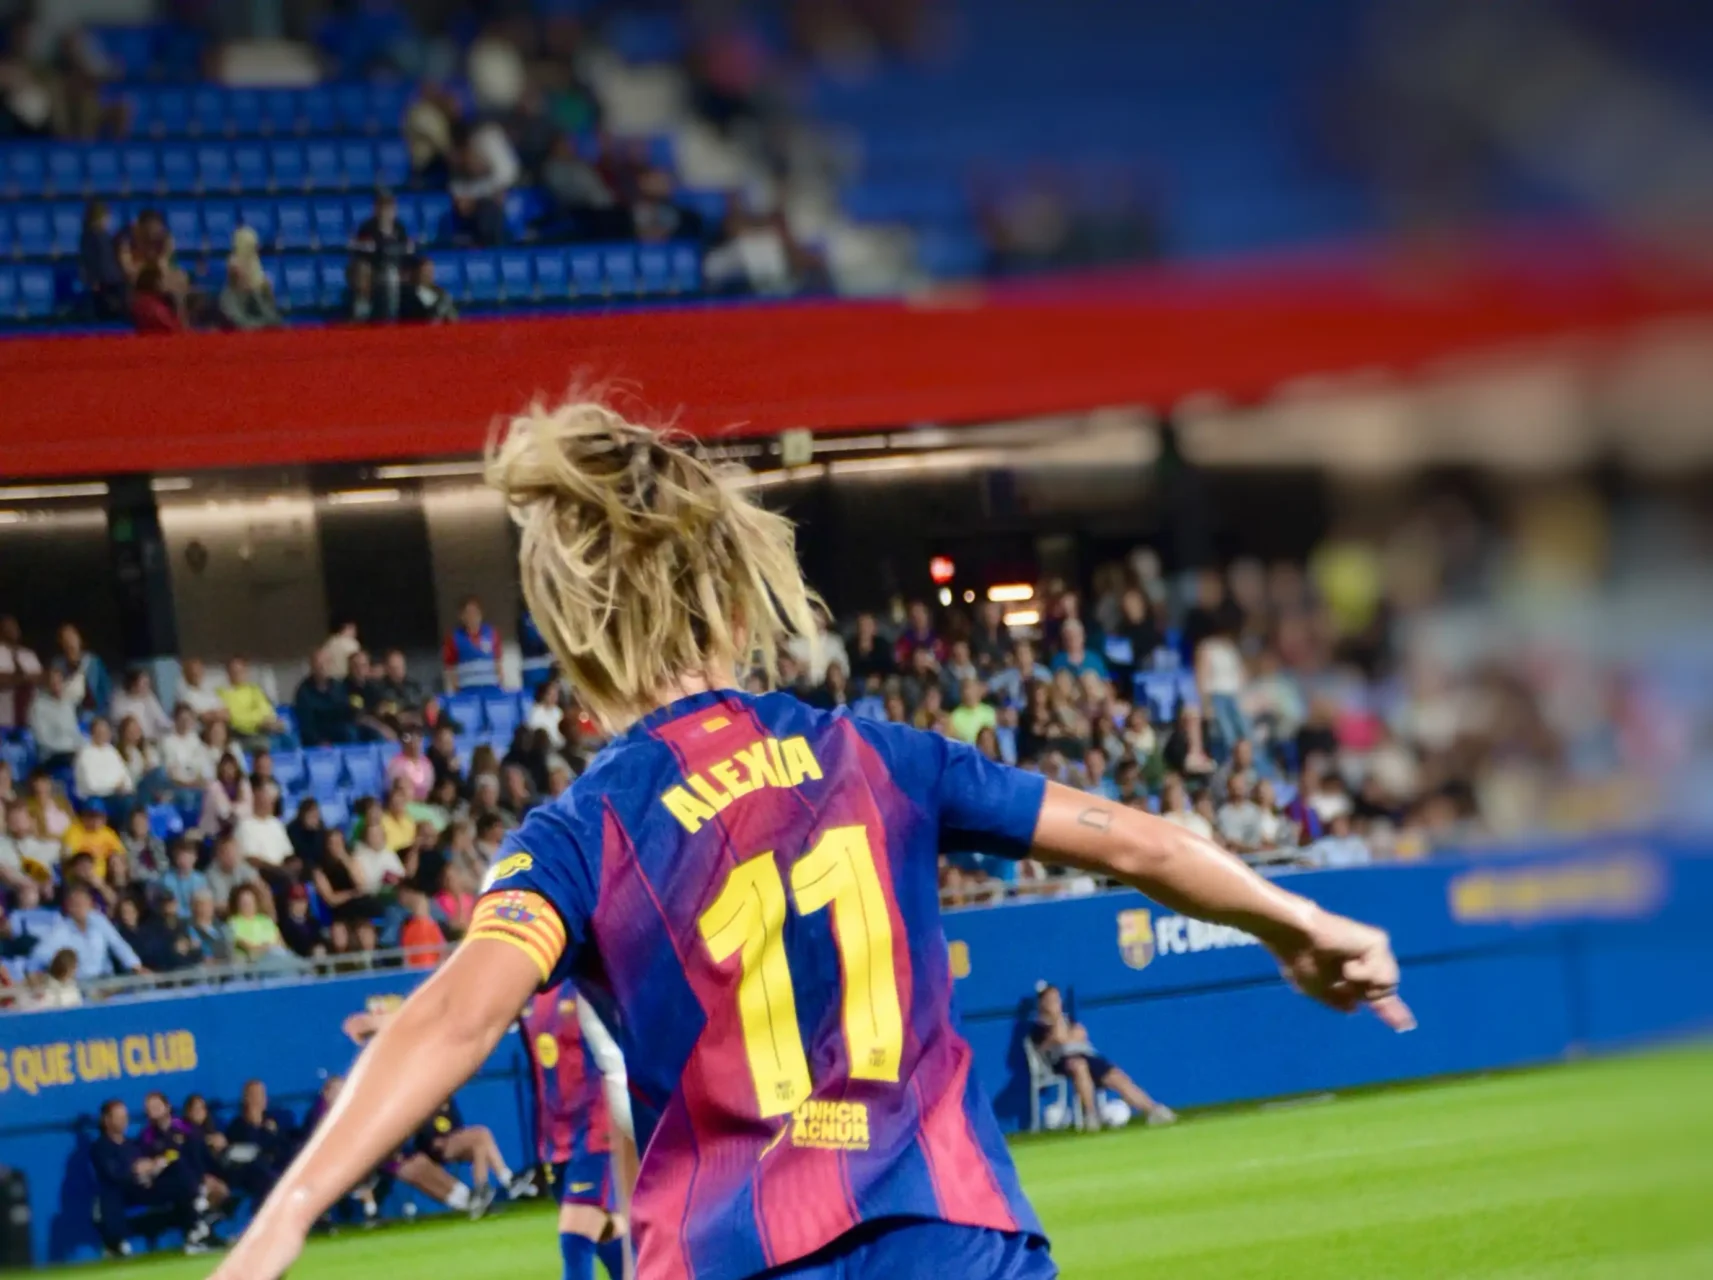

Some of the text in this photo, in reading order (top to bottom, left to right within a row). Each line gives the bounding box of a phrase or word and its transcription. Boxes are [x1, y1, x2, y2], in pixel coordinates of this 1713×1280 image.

[661, 735, 823, 834] ALEXIA
[1155, 915, 1189, 956] FC
[699, 825, 903, 1119] 11
[12, 1042, 75, 1095] QUE
[76, 1037, 121, 1082] UN
[122, 1030, 198, 1077] CLUB
[792, 1120, 869, 1142] ACNUR
[793, 1100, 868, 1122] UNHCR
